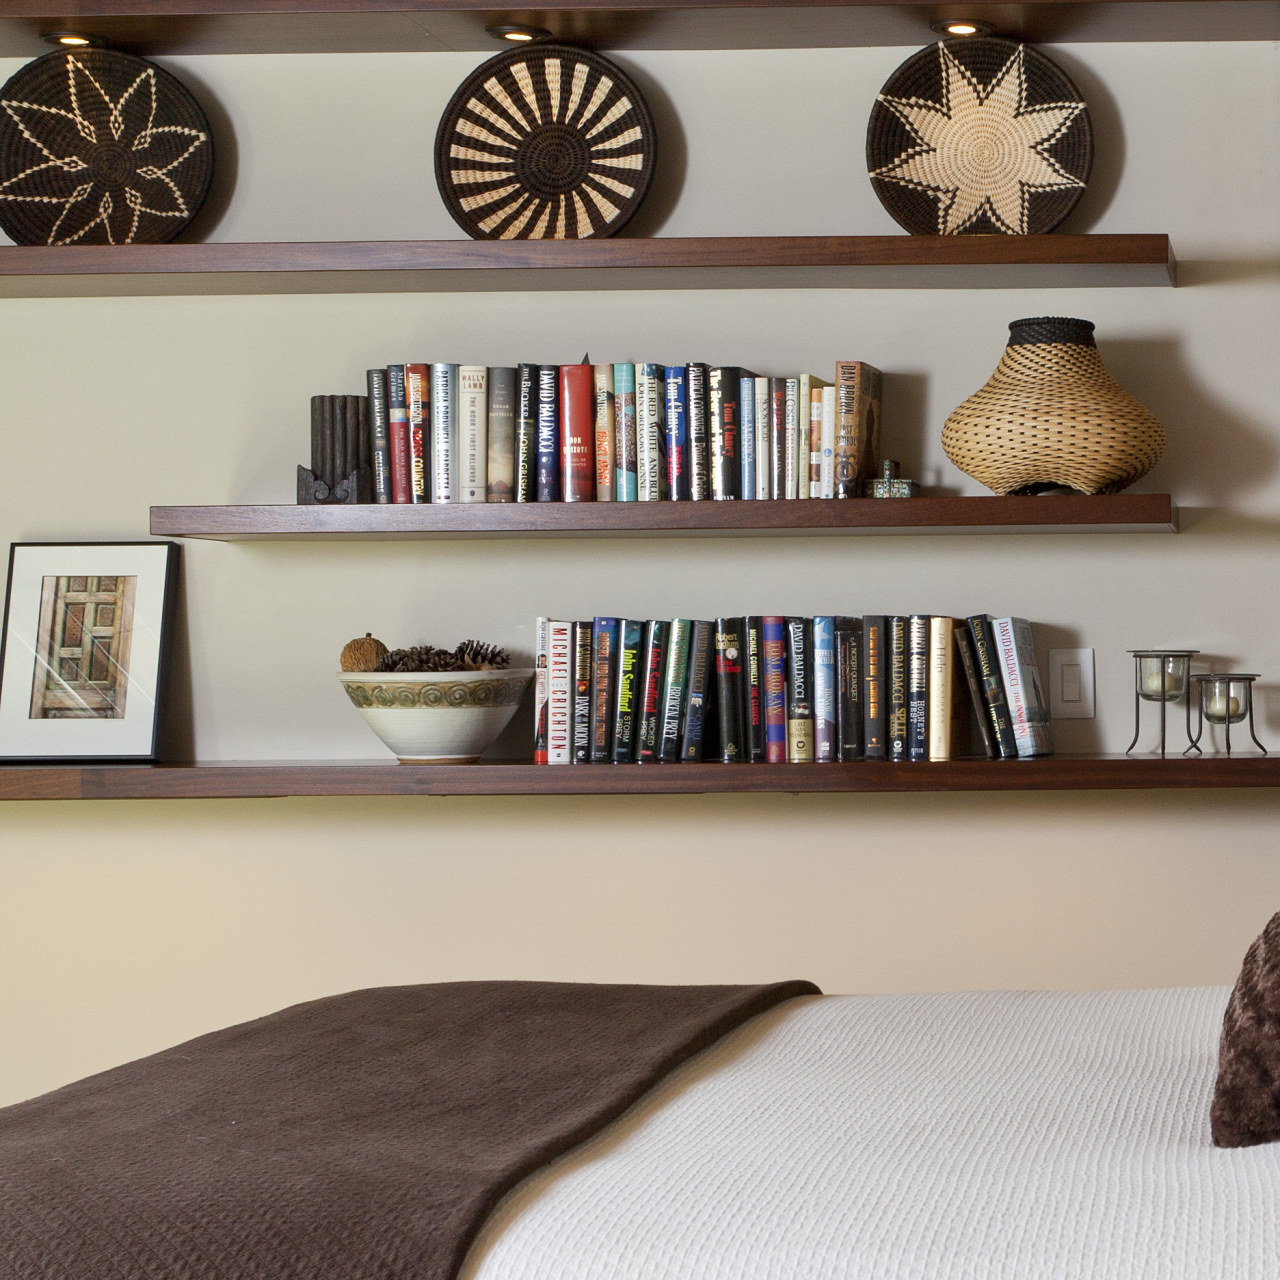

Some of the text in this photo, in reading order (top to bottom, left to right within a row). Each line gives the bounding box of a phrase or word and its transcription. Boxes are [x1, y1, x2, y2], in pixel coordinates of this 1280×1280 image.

[409, 373, 423, 424] JAMES PATTERSON
[522, 381, 531, 417] BROKER
[539, 370, 555, 401] DAVID
[597, 375, 608, 426] JAMES PATTERSON
[637, 383, 646, 407] JOHN
[667, 376, 682, 400] Tom
[710, 370, 723, 389] The
[839, 365, 856, 415] DAN BROWN
[373, 373, 385, 436] DAVID BALDACCI
[666, 401, 682, 437] Clancy
[690, 367, 704, 439] PATRICIA CORNWELL
[711, 391, 723, 412] Bear
[761, 398, 769, 443] MOON TIGER
[785, 381, 796, 426] BILL COSBY
[539, 403, 555, 453] BALDACCI
[638, 409, 646, 453] GREGORY
[648, 376, 658, 502] THE RED WHITE AND BLUE
[711, 416, 723, 433] and
[722, 401, 737, 458] Tom Clancy
[742, 421, 753, 464] AMERICA
[412, 428, 425, 496] CROSS COUNTRY
[520, 435, 529, 503] JOHN GRISHAM
[563, 446, 588, 454] QIXOTE
[597, 430, 610, 486] MARY MARY
[692, 442, 707, 500] Point of Origin
[375, 451, 384, 493] COLLECTORS
[552, 627, 568, 680] MICHAEL
[716, 632, 738, 641] Robert
[716, 640, 739, 650] Ludlum
[749, 628, 759, 686] MICHAEL CONNELLY
[911, 619, 926, 652] PATRICIA
[938, 632, 946, 645] The
[973, 619, 991, 675] JOHN GRISHAM
[999, 621, 1020, 687] DAVID BALDACCI
[538, 670, 546, 680] GET
[577, 646, 591, 680] SANDFORD
[597, 632, 610, 690] ROBERT LUDLUM
[619, 649, 637, 712] John Sandford
[643, 648, 661, 713] John Sandford
[694, 625, 710, 693] DAVID BALDACCI
[771, 640, 782, 715] TOM BROKAW
[794, 624, 805, 699] DAVID BALDACCI
[850, 637, 858, 702] A NORTH QUARTET
[892, 621, 904, 704] DAVID BALDACCI
[936, 648, 947, 673] Help
[538, 681, 546, 695] WITH
[538, 696, 546, 705] THE
[575, 696, 589, 717] DARK
[824, 688, 833, 711] HONOR
[551, 690, 567, 750] CRICHTON
[615, 718, 623, 739] PREY
[622, 715, 631, 742] STORM
[640, 720, 648, 741] PREY
[647, 716, 656, 746] WICKED
[664, 686, 682, 740] BROKEN PREY
[895, 708, 906, 737] SPLIT
[910, 701, 918, 723] NEST
[1014, 704, 1029, 738] INNOCENT
[574, 723, 589, 747] MOON
